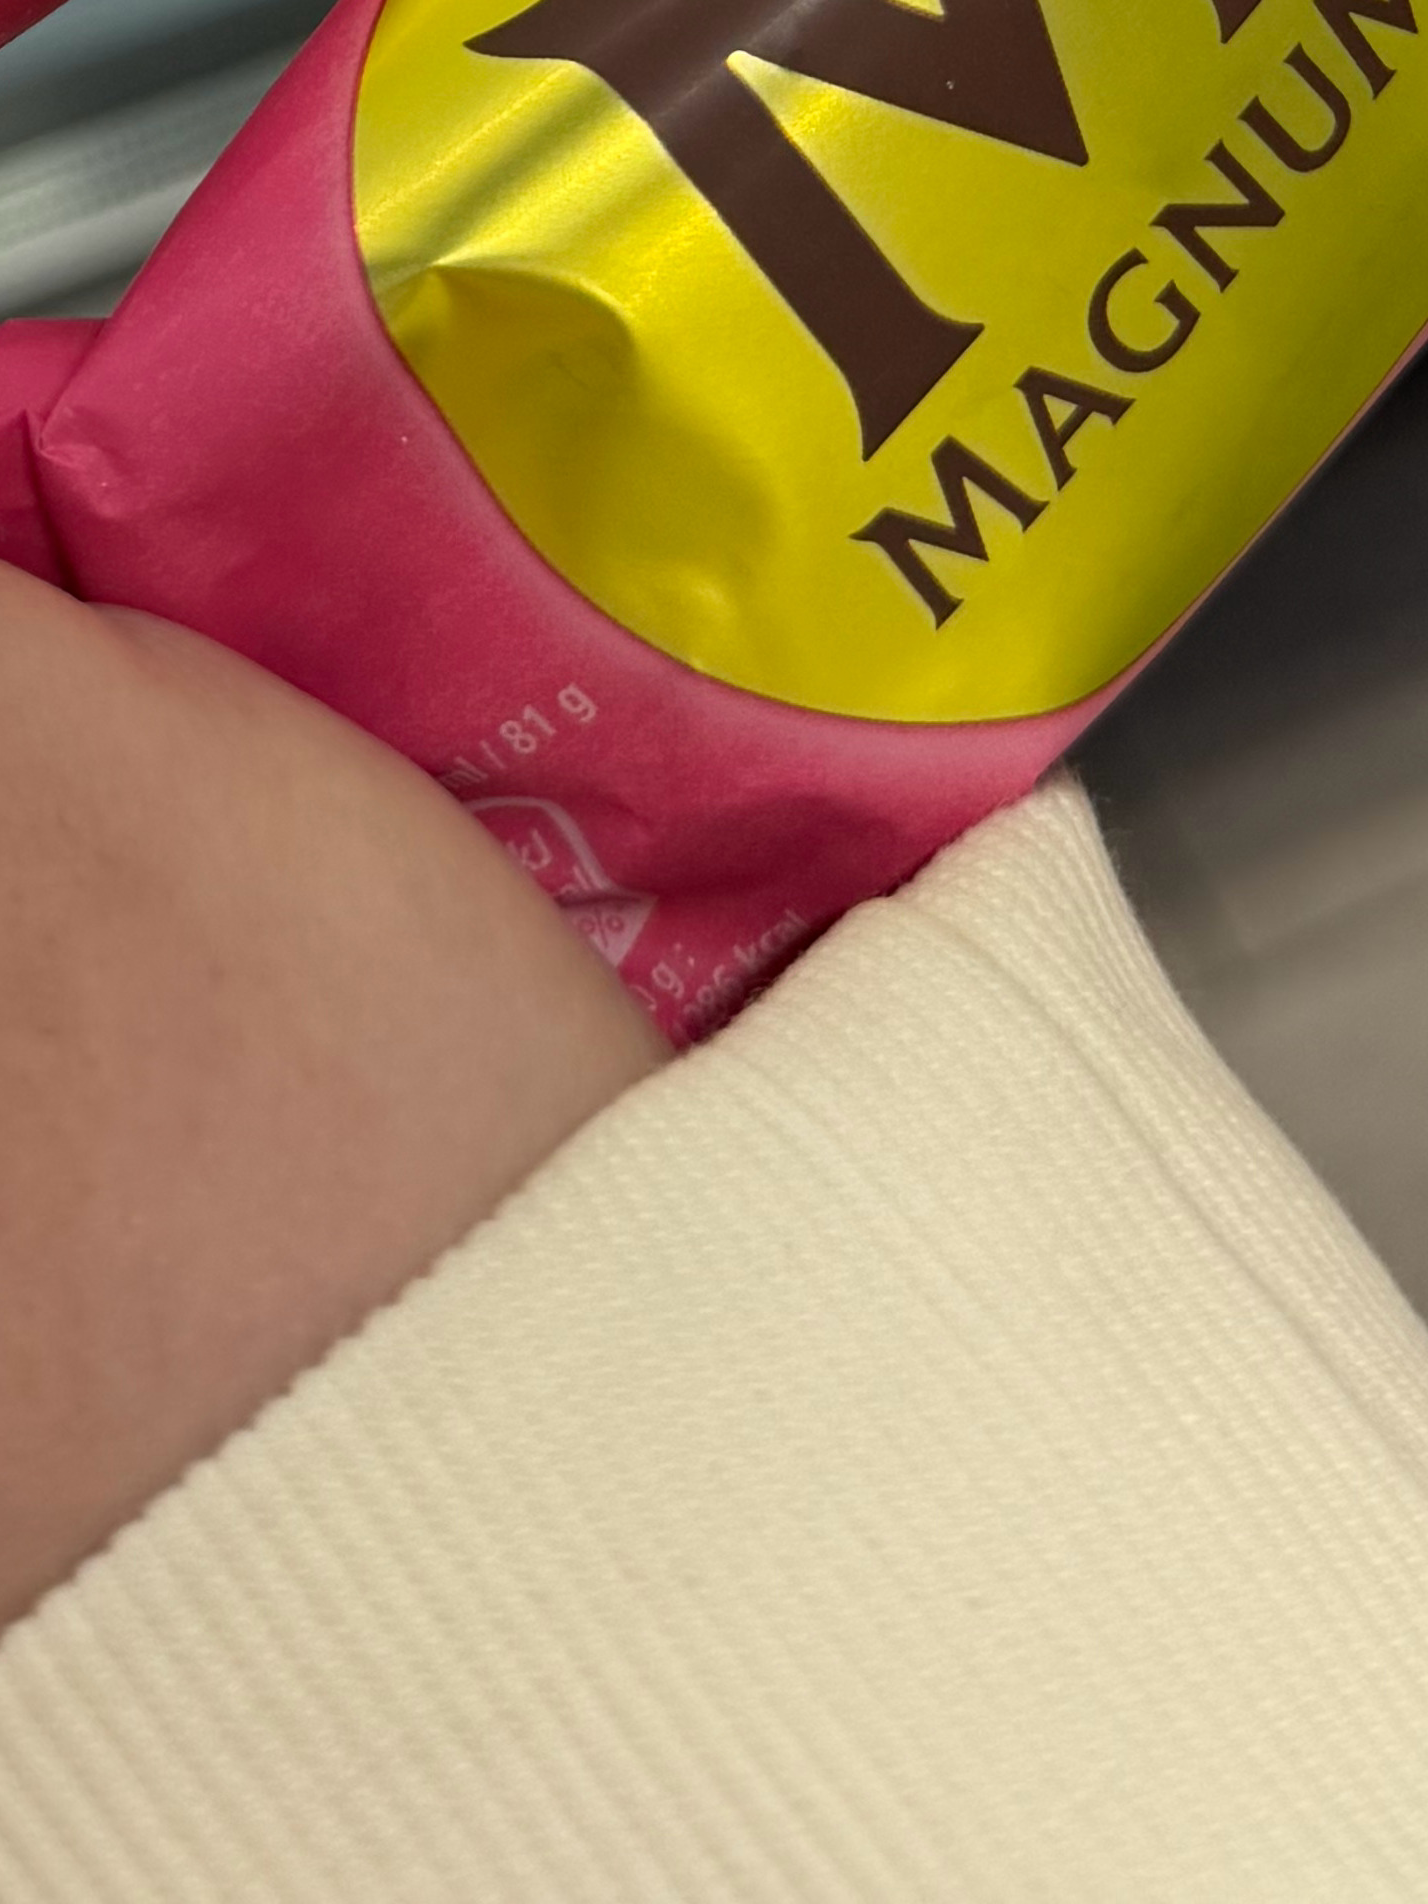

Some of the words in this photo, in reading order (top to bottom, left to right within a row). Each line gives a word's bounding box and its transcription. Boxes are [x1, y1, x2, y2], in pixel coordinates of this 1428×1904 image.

[480, 739, 507, 771] /
[499, 703, 557, 755] 81
[557, 683, 599, 724] g
